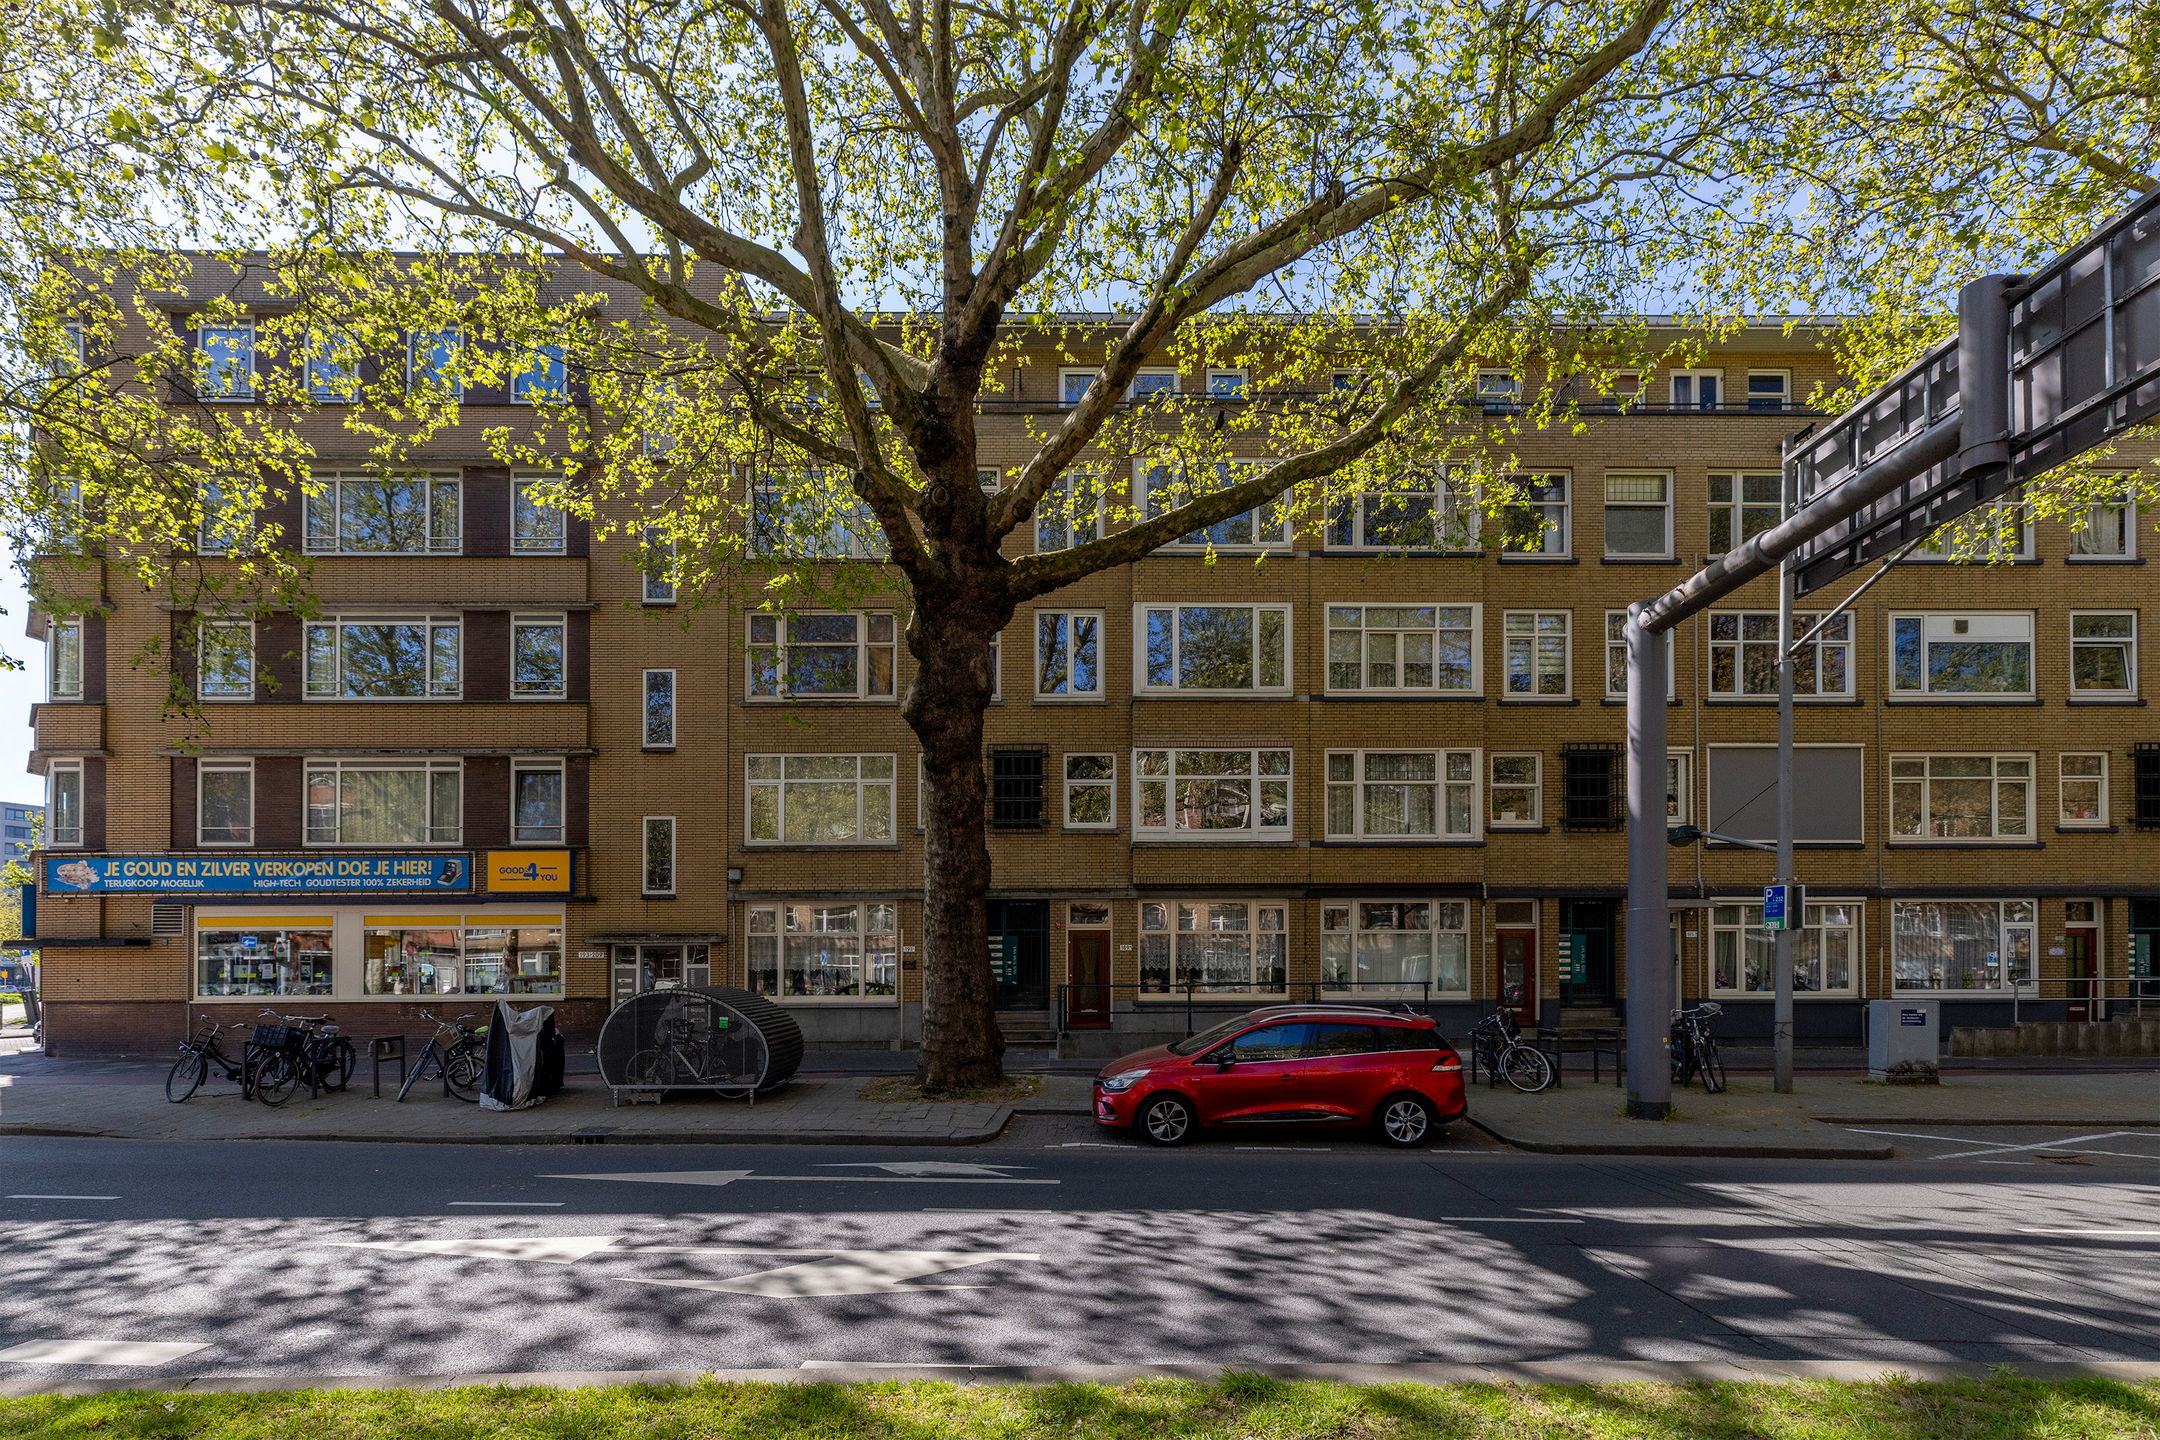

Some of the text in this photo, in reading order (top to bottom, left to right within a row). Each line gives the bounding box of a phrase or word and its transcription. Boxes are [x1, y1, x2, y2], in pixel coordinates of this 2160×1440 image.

[104, 861, 432, 877] JE GOUD EN ZILVER VERKOPEN DOE JE HIER!
[104, 879, 205, 888] TERUGKOOP MOGELIJK
[253, 878, 432, 888] HIGH-TECH GOUDTESTER 100% ZEKERHEID
[1766, 888, 1773, 903] P
